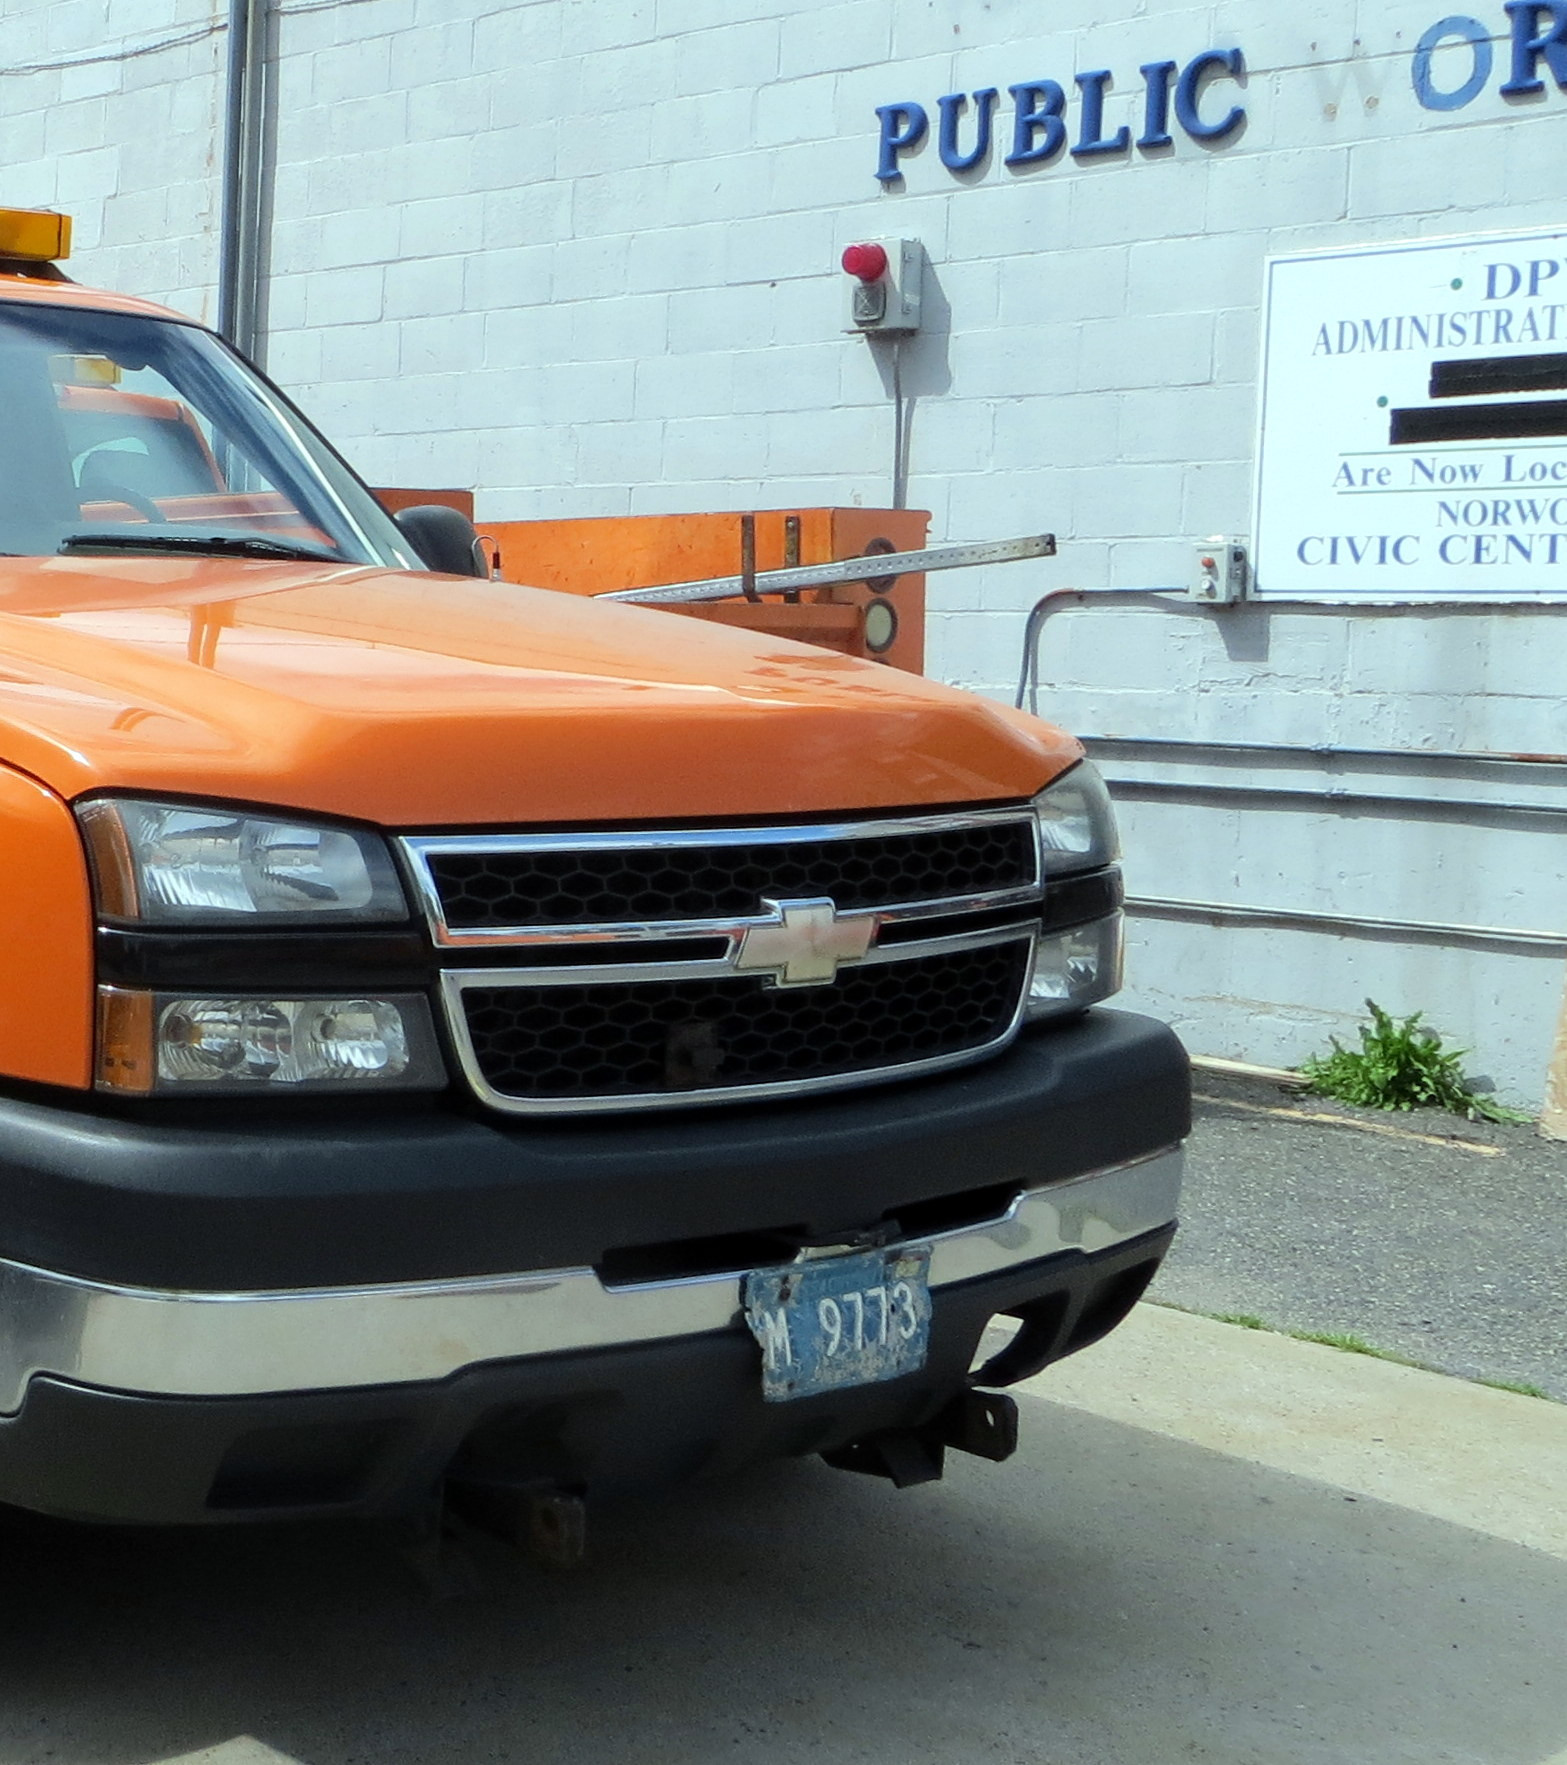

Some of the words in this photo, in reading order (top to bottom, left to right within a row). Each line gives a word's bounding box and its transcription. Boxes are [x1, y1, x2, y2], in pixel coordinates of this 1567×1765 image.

[874, 48, 1245, 180] PUBLIC
[1482, 256, 1567, 301] DP
[1311, 303, 1567, 356] ADMINISTRAT
[1331, 461, 1392, 488] Are
[1409, 457, 1483, 486] Now
[1296, 535, 1421, 566] CIVIC
[1438, 534, 1567, 566] CENT
[818, 1280, 917, 1357] 9773
